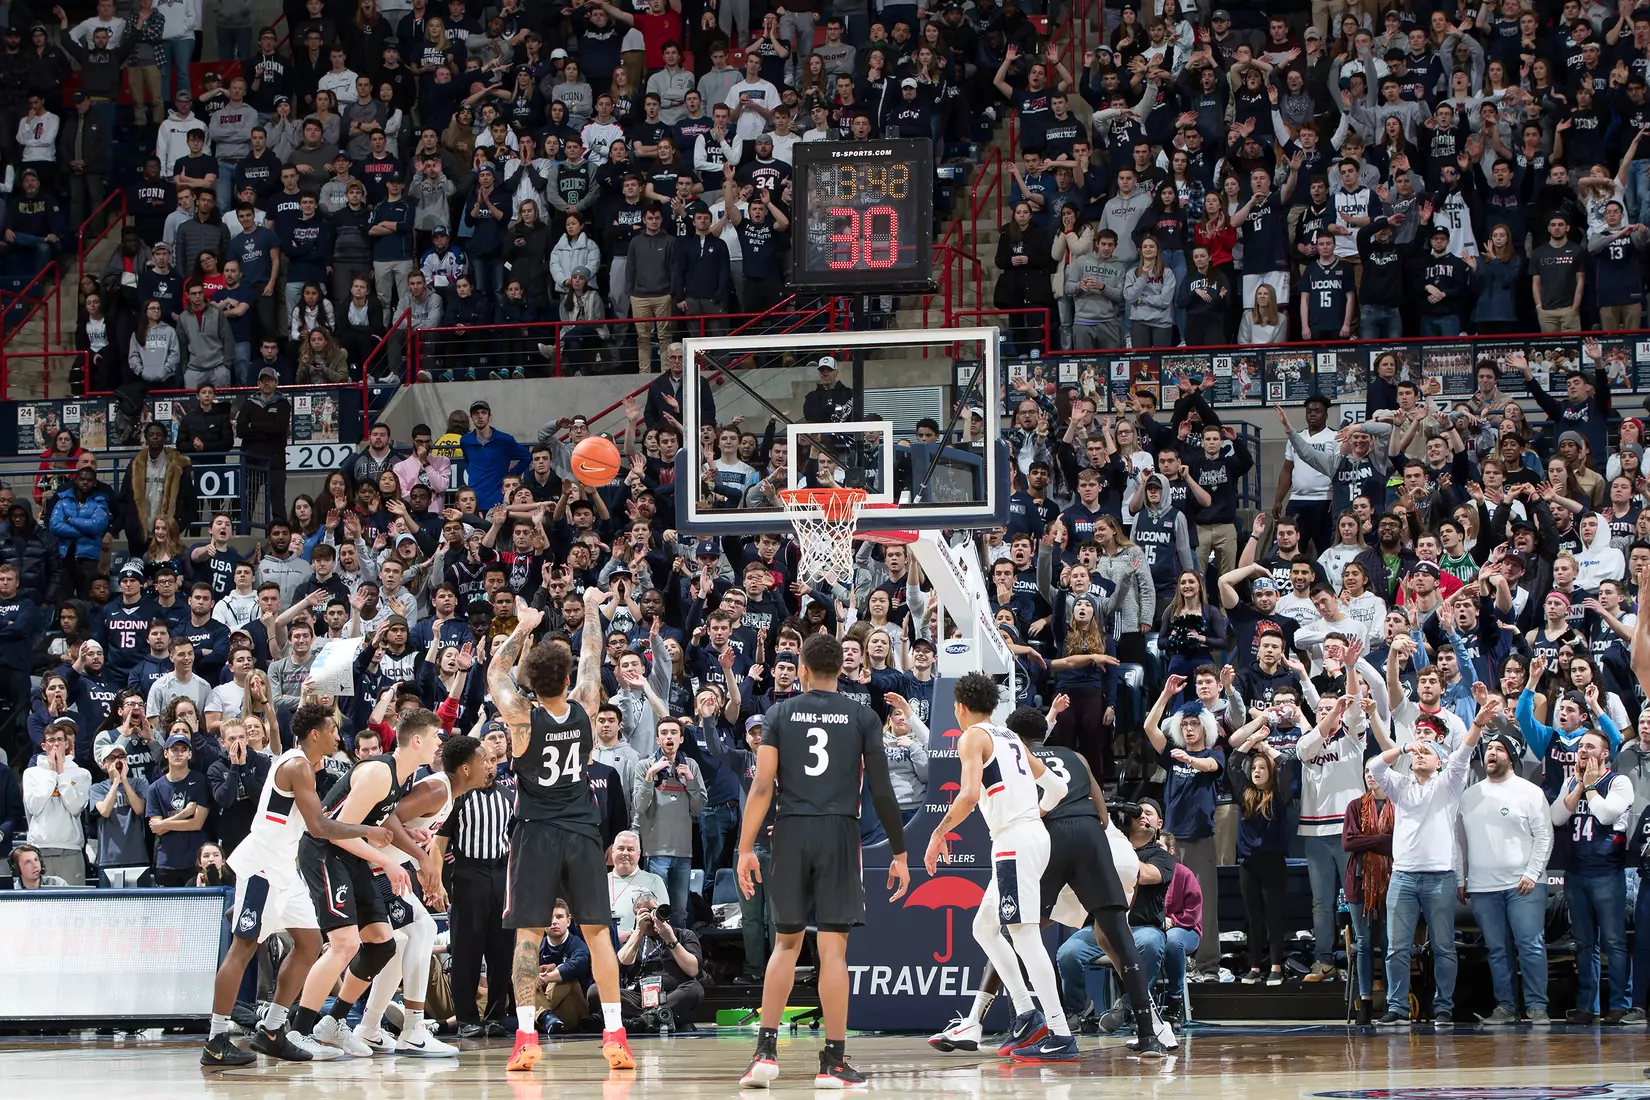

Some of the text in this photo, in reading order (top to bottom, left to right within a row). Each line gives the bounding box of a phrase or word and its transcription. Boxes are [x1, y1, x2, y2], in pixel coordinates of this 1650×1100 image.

[1567, 54, 1584, 66] UCO
[832, 150, 892, 158] TS-SPORTS.COM
[560, 178, 586, 191] CELTICS
[756, 177, 775, 190] 34
[837, 163, 909, 200] 3:42
[568, 191, 579, 205] 8
[277, 202, 299, 212] UCON
[1111, 207, 1136, 215] UCONN
[1337, 204, 1366, 213] UCONN
[1449, 212, 1461, 229] 15
[294, 228, 319, 239] UCONN
[676, 223, 686, 236] 13
[829, 206, 898, 271] 30
[1609, 246, 1623, 260] 13
[1541, 256, 1573, 266] UCONN
[1085, 266, 1117, 277] UCONN
[1311, 279, 1342, 290] UCONN
[1320, 291, 1332, 308] 15
[1217, 359, 1228, 368] 20
[1322, 355, 1331, 364] 31
[1014, 367, 1022, 376] 32
[1066, 365, 1071, 374] 3
[20, 408, 32, 417] 24
[66, 406, 78, 415] 50
[158, 403, 169, 412] 52
[298, 446, 354, 468] 202
[1338, 467, 1372, 481] UCONN
[200, 470, 235, 496] 01
[1609, 522, 1635, 535] CONN
[1136, 530, 1170, 543] UCONN
[210, 559, 233, 573] USA
[212, 573, 227, 592] 15
[1013, 580, 1039, 591] CONN
[109, 621, 148, 630] UCONN
[741, 617, 772, 630] USKIES
[120, 632, 136, 648] 15
[187, 633, 210, 641] CONN
[425, 640, 459, 649] UONN
[1533, 648, 1559, 657] UCON
[282, 672, 309, 682] UCON
[90, 692, 116, 701] UCON
[101, 702, 111, 717] 3
[1250, 699, 1272, 709] UCO
[790, 713, 849, 724] ADAMS-WOODS
[545, 730, 581, 742] CUMBERLAND
[803, 727, 830, 776] 3
[928, 750, 959, 758] TRAVEL
[127, 753, 152, 765] CONN
[538, 742, 582, 787] 34
[1009, 743, 1026, 775] 2
[1572, 816, 1593, 842] 34
[936, 854, 975, 862] AVELERS
[847, 966, 981, 996] TRAVEL
